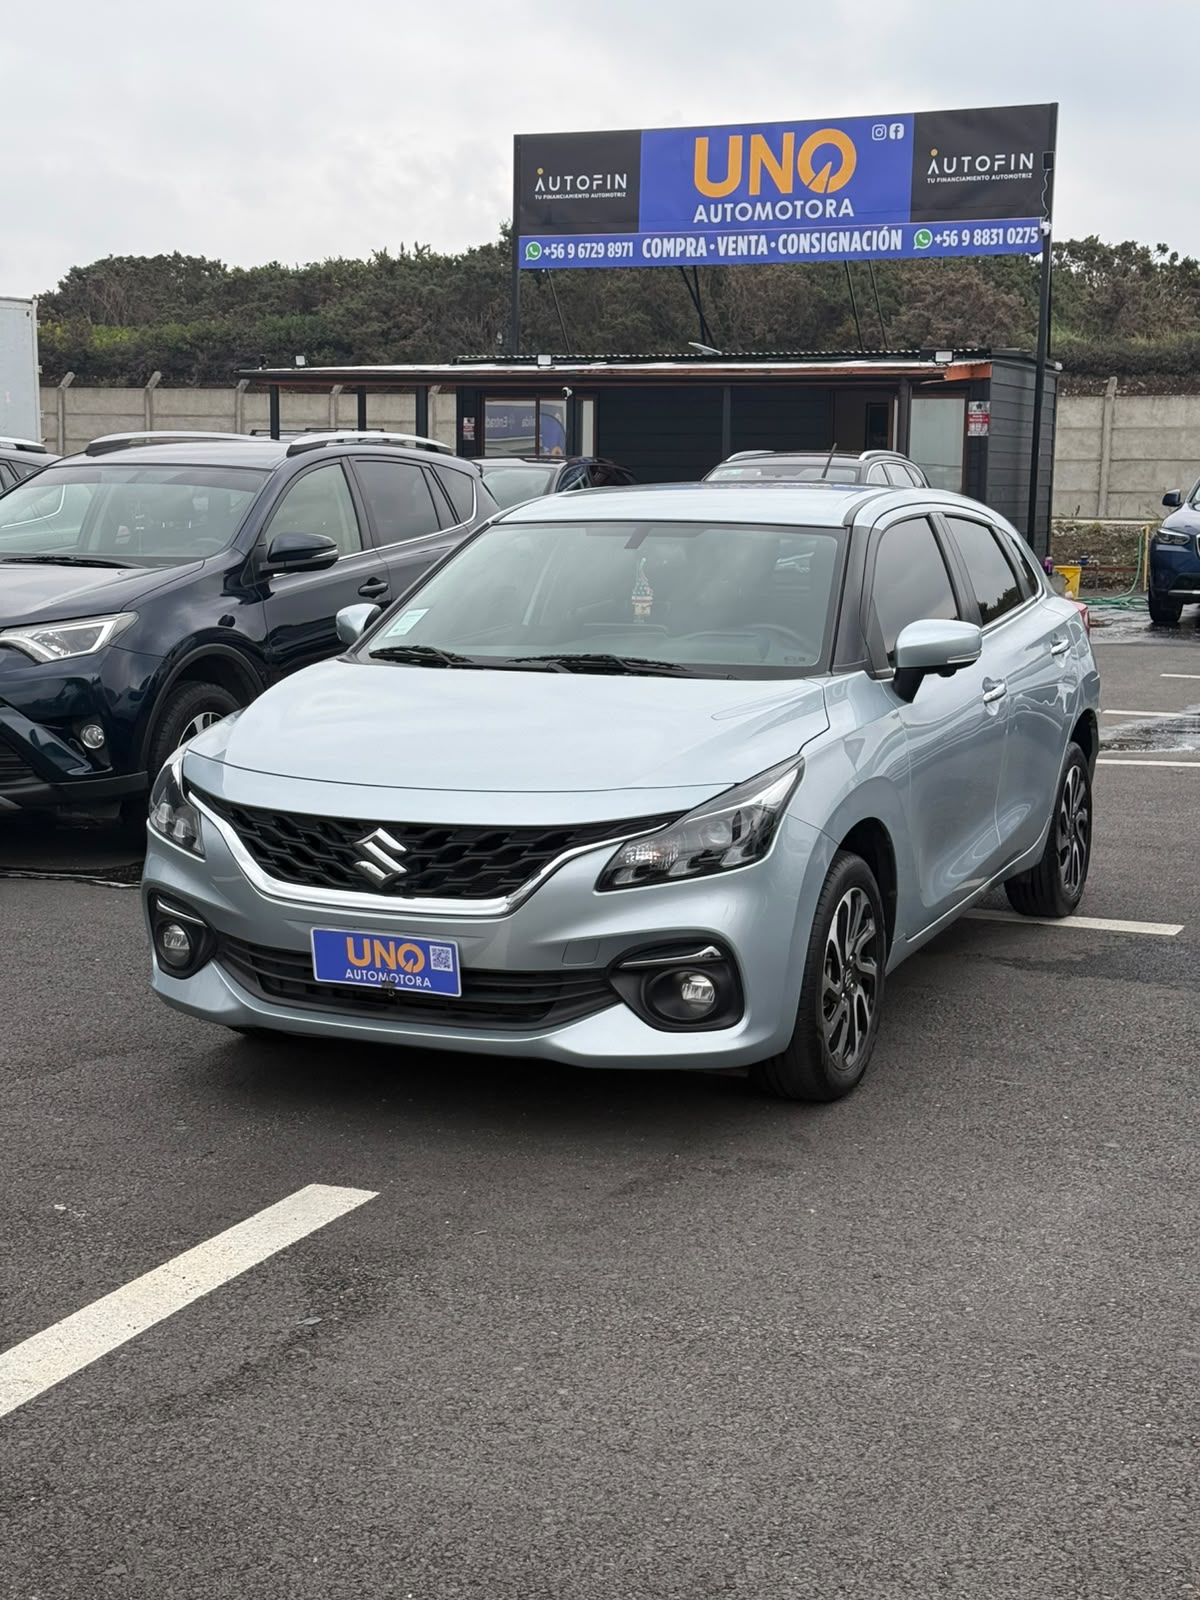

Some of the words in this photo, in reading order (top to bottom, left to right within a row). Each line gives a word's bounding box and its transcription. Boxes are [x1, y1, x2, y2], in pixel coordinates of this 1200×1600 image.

[694, 128, 857, 198] UNO
[927, 149, 1034, 175] AUTOFIN
[534, 168, 627, 192] AUTOFIN
[936, 174, 990, 183] FINANCIAMIENTO
[991, 172, 1033, 180] AUTOMOTRIZ
[693, 198, 854, 223] AUTOMOTORA
[642, 236, 707, 258] COMPRA
[717, 235, 769, 256] VENTA
[777, 226, 902, 255] CONSIGNACIÓN
[934, 230, 958, 247] +56
[961, 229, 970, 246] 9
[973, 228, 1004, 246] 8831
[1006, 226, 1039, 244] 0275
[543, 243, 565, 259] +56
[567, 243, 575, 259] 9
[577, 242, 605, 259] 6729
[607, 241, 633, 257] 8971
[346, 936, 425, 974] UNO
[345, 968, 432, 988] AUTOMOTORA
